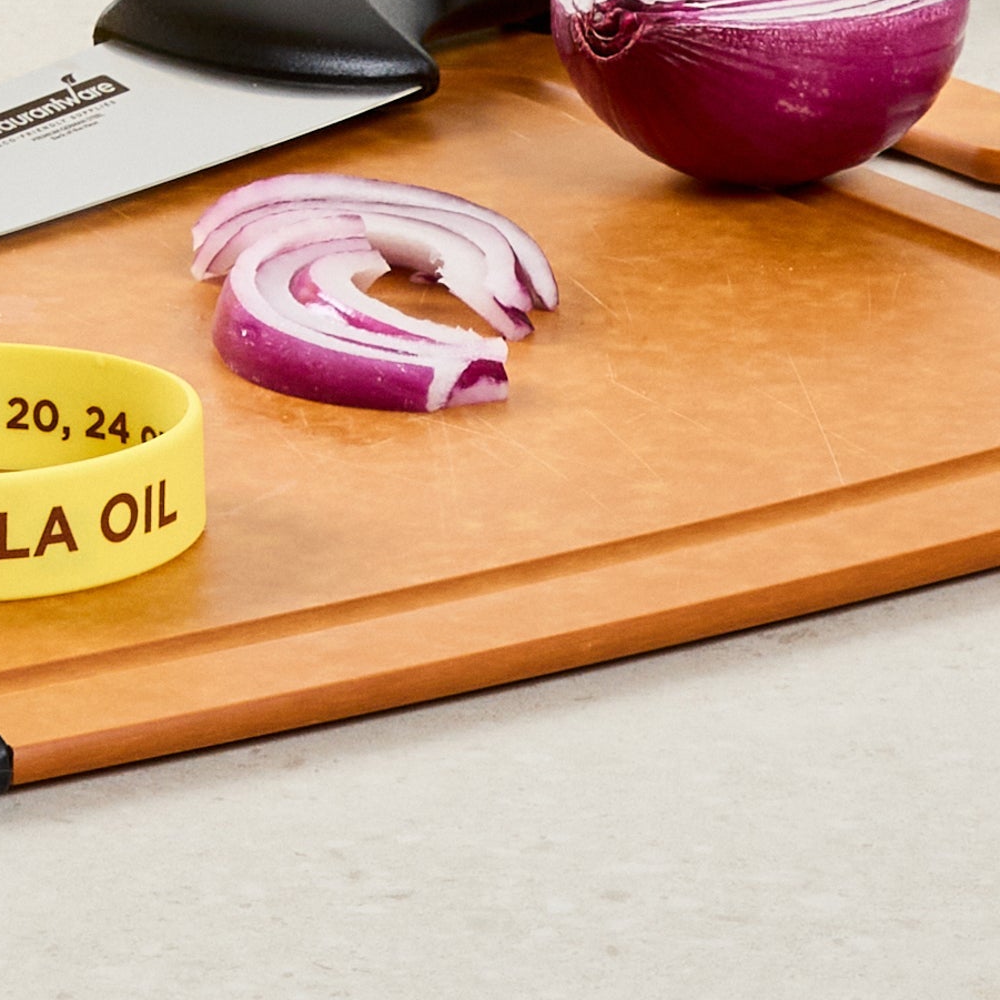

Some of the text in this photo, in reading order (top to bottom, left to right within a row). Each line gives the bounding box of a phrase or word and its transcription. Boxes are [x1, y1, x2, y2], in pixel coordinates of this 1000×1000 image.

[6, 397, 72, 441] 20,
[84, 405, 130, 445] 24
[100, 479, 179, 544] OIL
